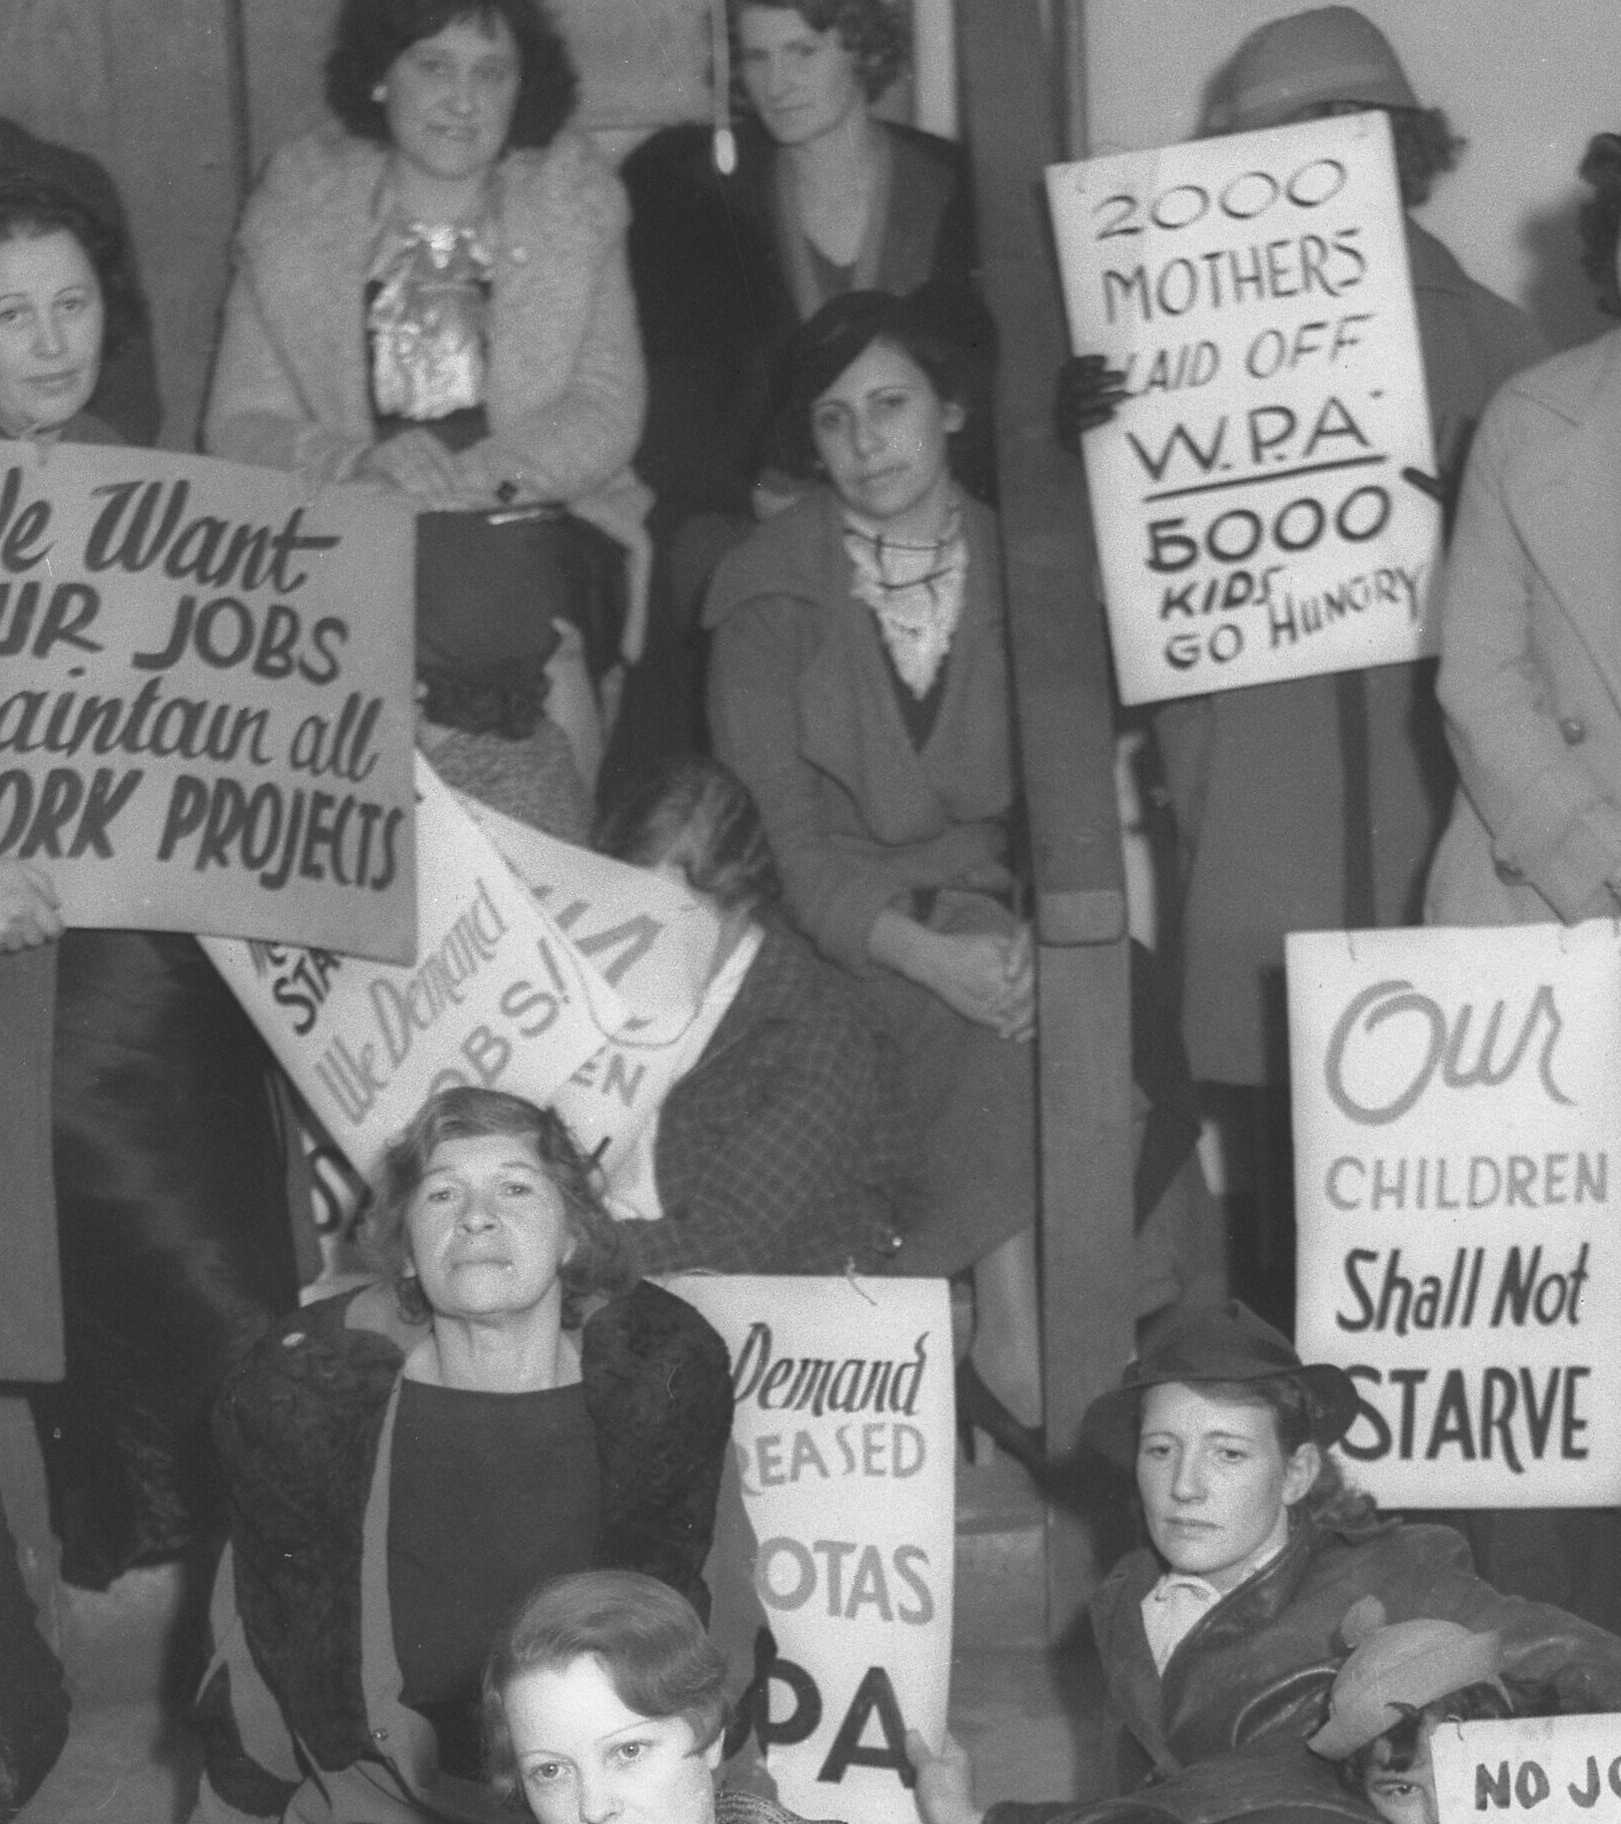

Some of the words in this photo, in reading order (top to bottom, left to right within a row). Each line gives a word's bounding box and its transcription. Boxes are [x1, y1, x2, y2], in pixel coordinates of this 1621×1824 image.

[1092, 158, 1347, 240] 2000
[1102, 229, 1368, 325] MOTHERS
[1245, 312, 1376, 380] OFF
[84, 478, 342, 594] Want
[1145, 485, 1392, 573] 5000
[131, 594, 350, 685] JOBS
[1159, 565, 1288, 621] KIDS
[1165, 623, 1244, 670] GO
[289, 691, 385, 784] all
[156, 774, 406, 892] PROJECTS
[369, 876, 509, 1070] Demand
[1324, 979, 1581, 1127] Our
[1323, 1152, 1610, 1211] CHILDREN
[1336, 1246, 1485, 1337] Shall
[1489, 1242, 1590, 1330] Not
[734, 1321, 932, 1418] Demand
[1338, 1364, 1592, 1475] STARVE
[759, 1536, 935, 1626] OTAS
[754, 1656, 918, 1790] PA
[1475, 1759, 1551, 1811] NO
